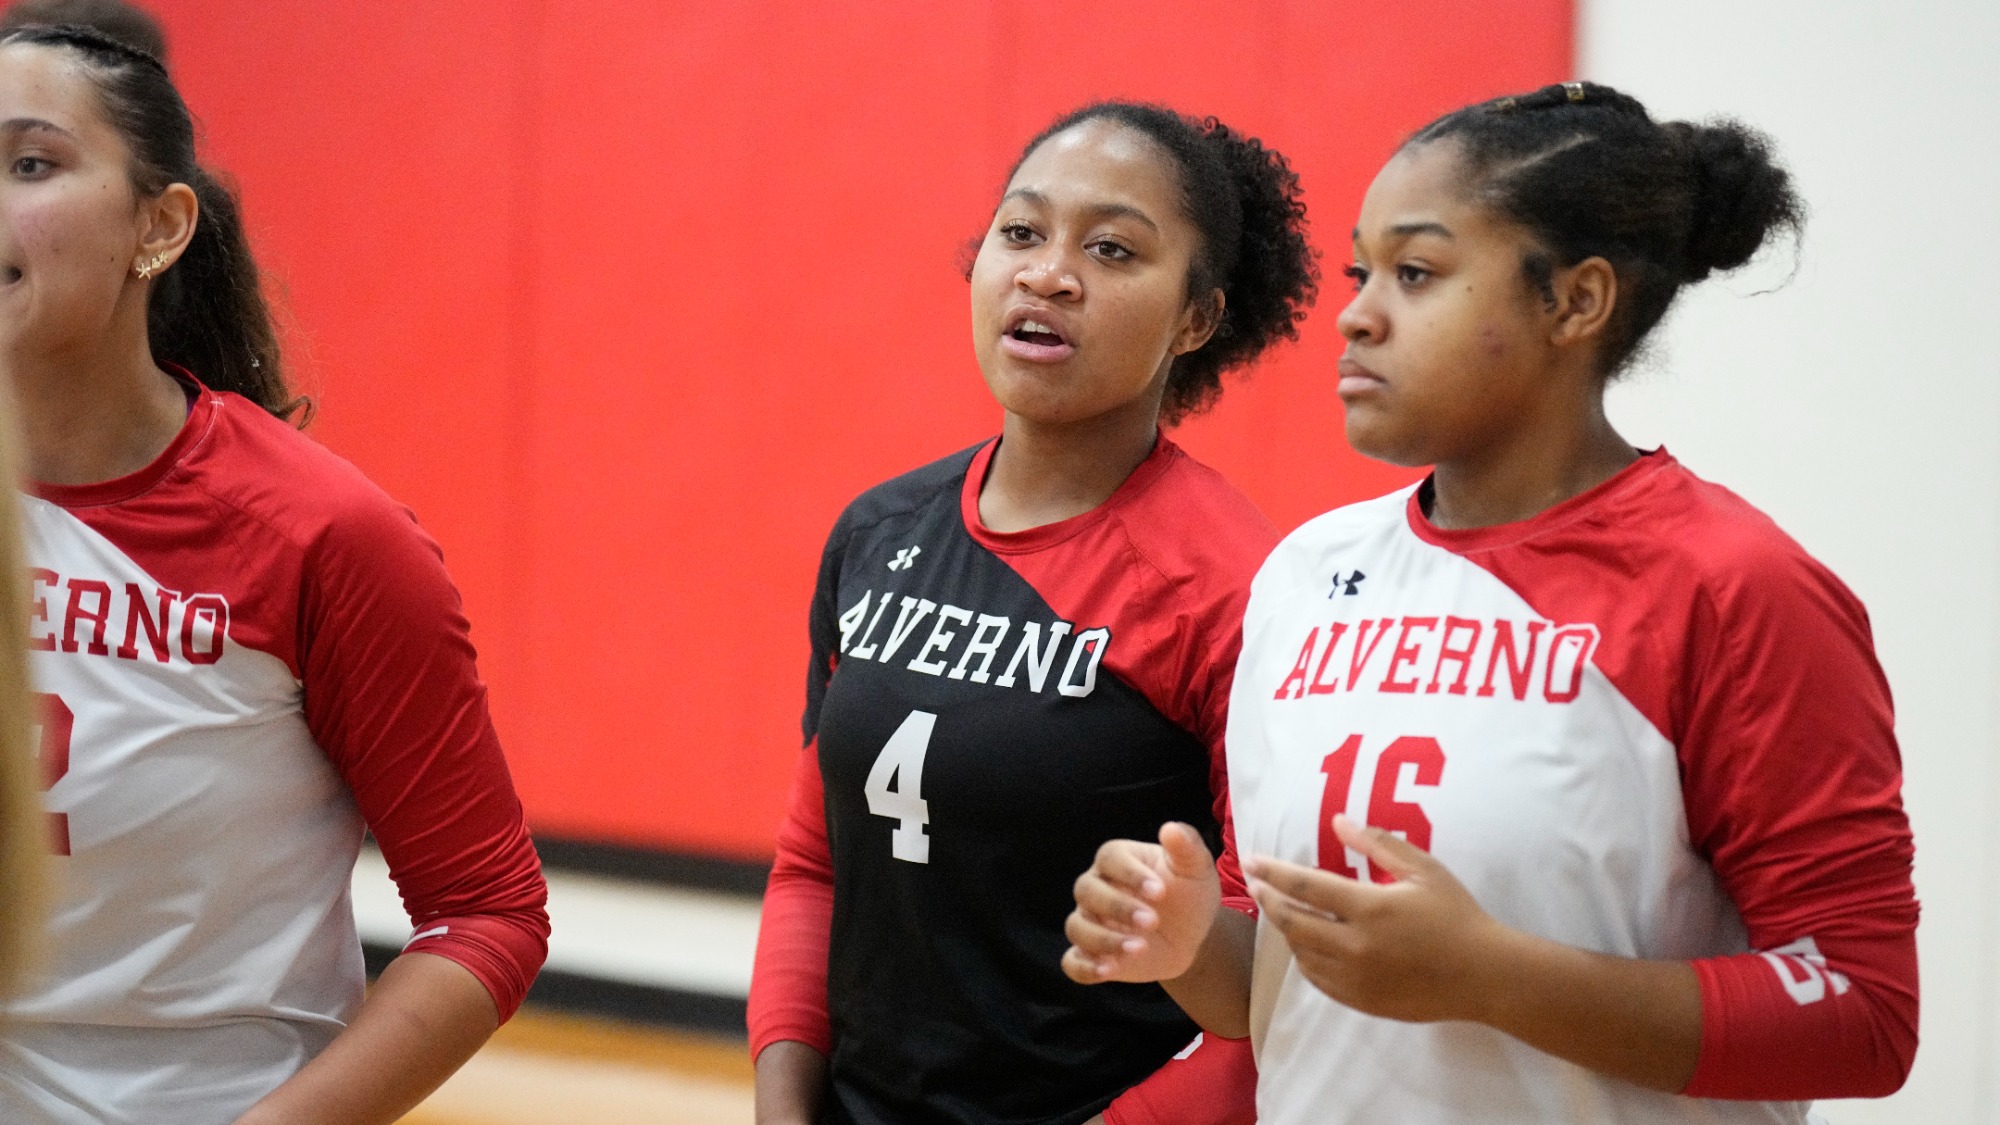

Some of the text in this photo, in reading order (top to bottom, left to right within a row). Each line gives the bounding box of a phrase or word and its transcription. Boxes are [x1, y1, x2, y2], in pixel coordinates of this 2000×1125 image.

[839, 589, 1111, 698] ALVERNO
[1273, 615, 1600, 704] ALVERNO
[864, 709, 938, 865] 4
[1316, 733, 1447, 886] 16
